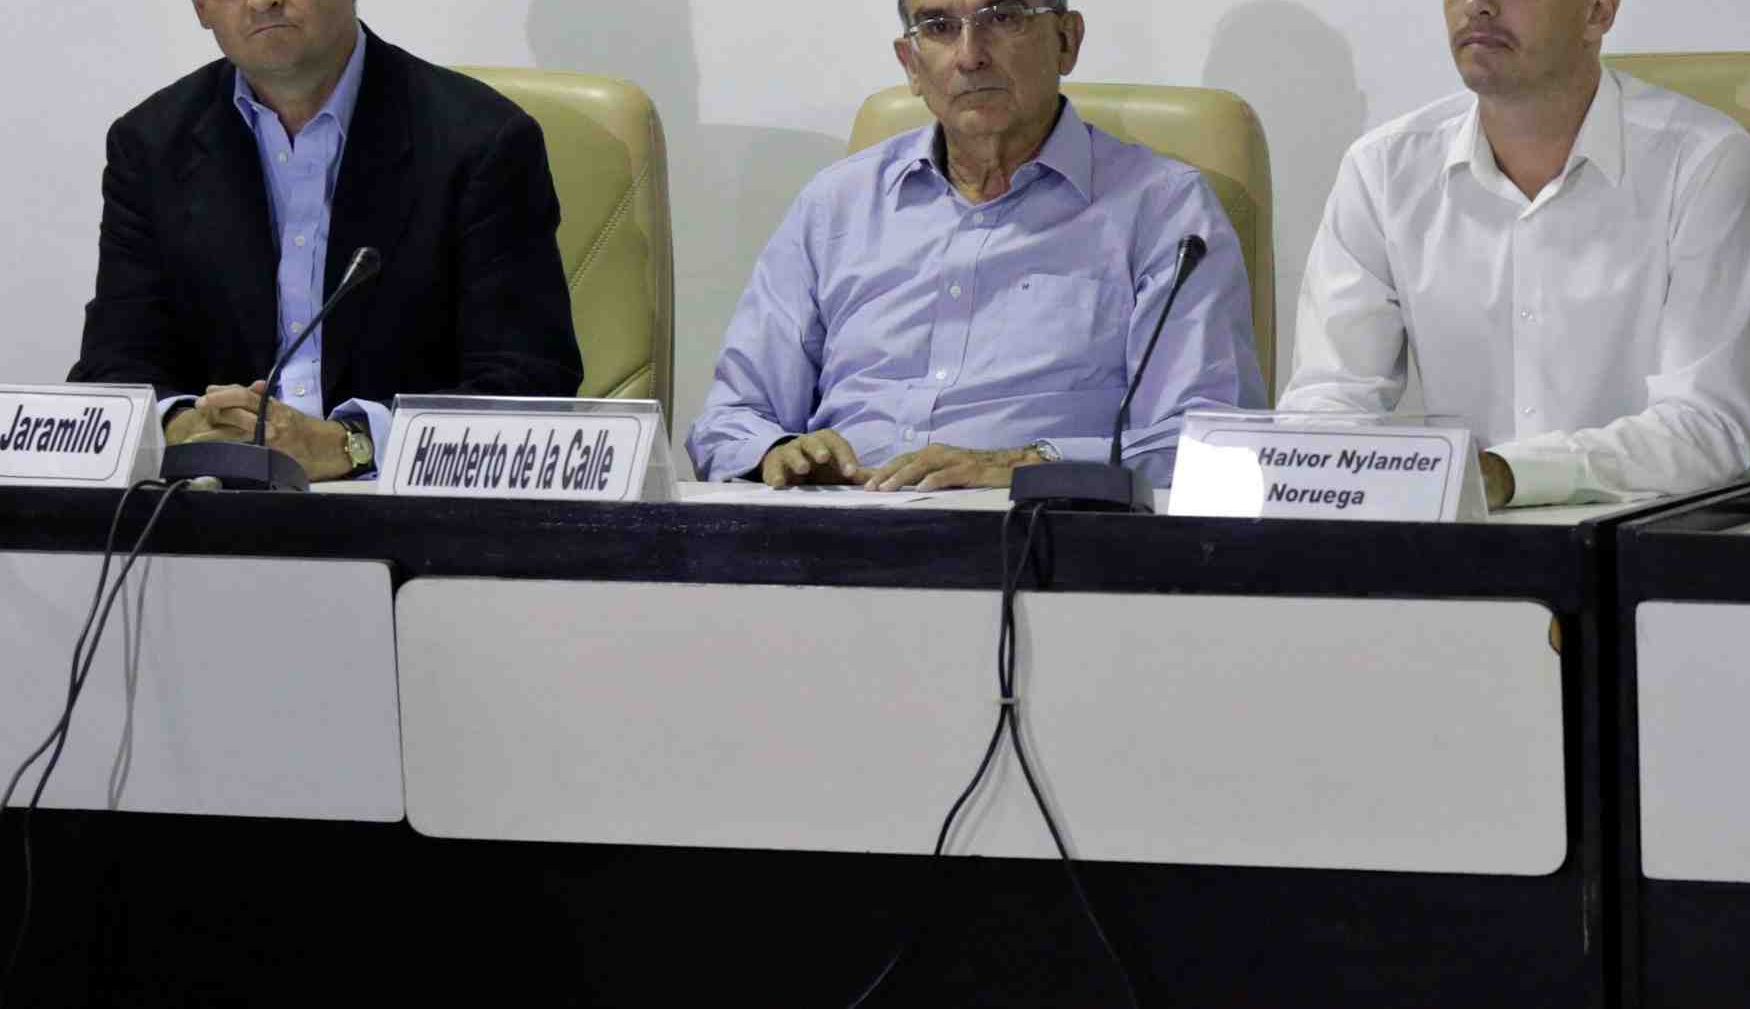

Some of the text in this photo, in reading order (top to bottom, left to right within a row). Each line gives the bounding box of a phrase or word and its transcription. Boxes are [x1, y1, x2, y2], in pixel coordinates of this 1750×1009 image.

[0, 404, 112, 455] Jaramillo
[407, 426, 615, 492] Humberto de la Calle
[1258, 446, 1442, 475] Halvor Nylander
[1267, 482, 1366, 510] Noruega
